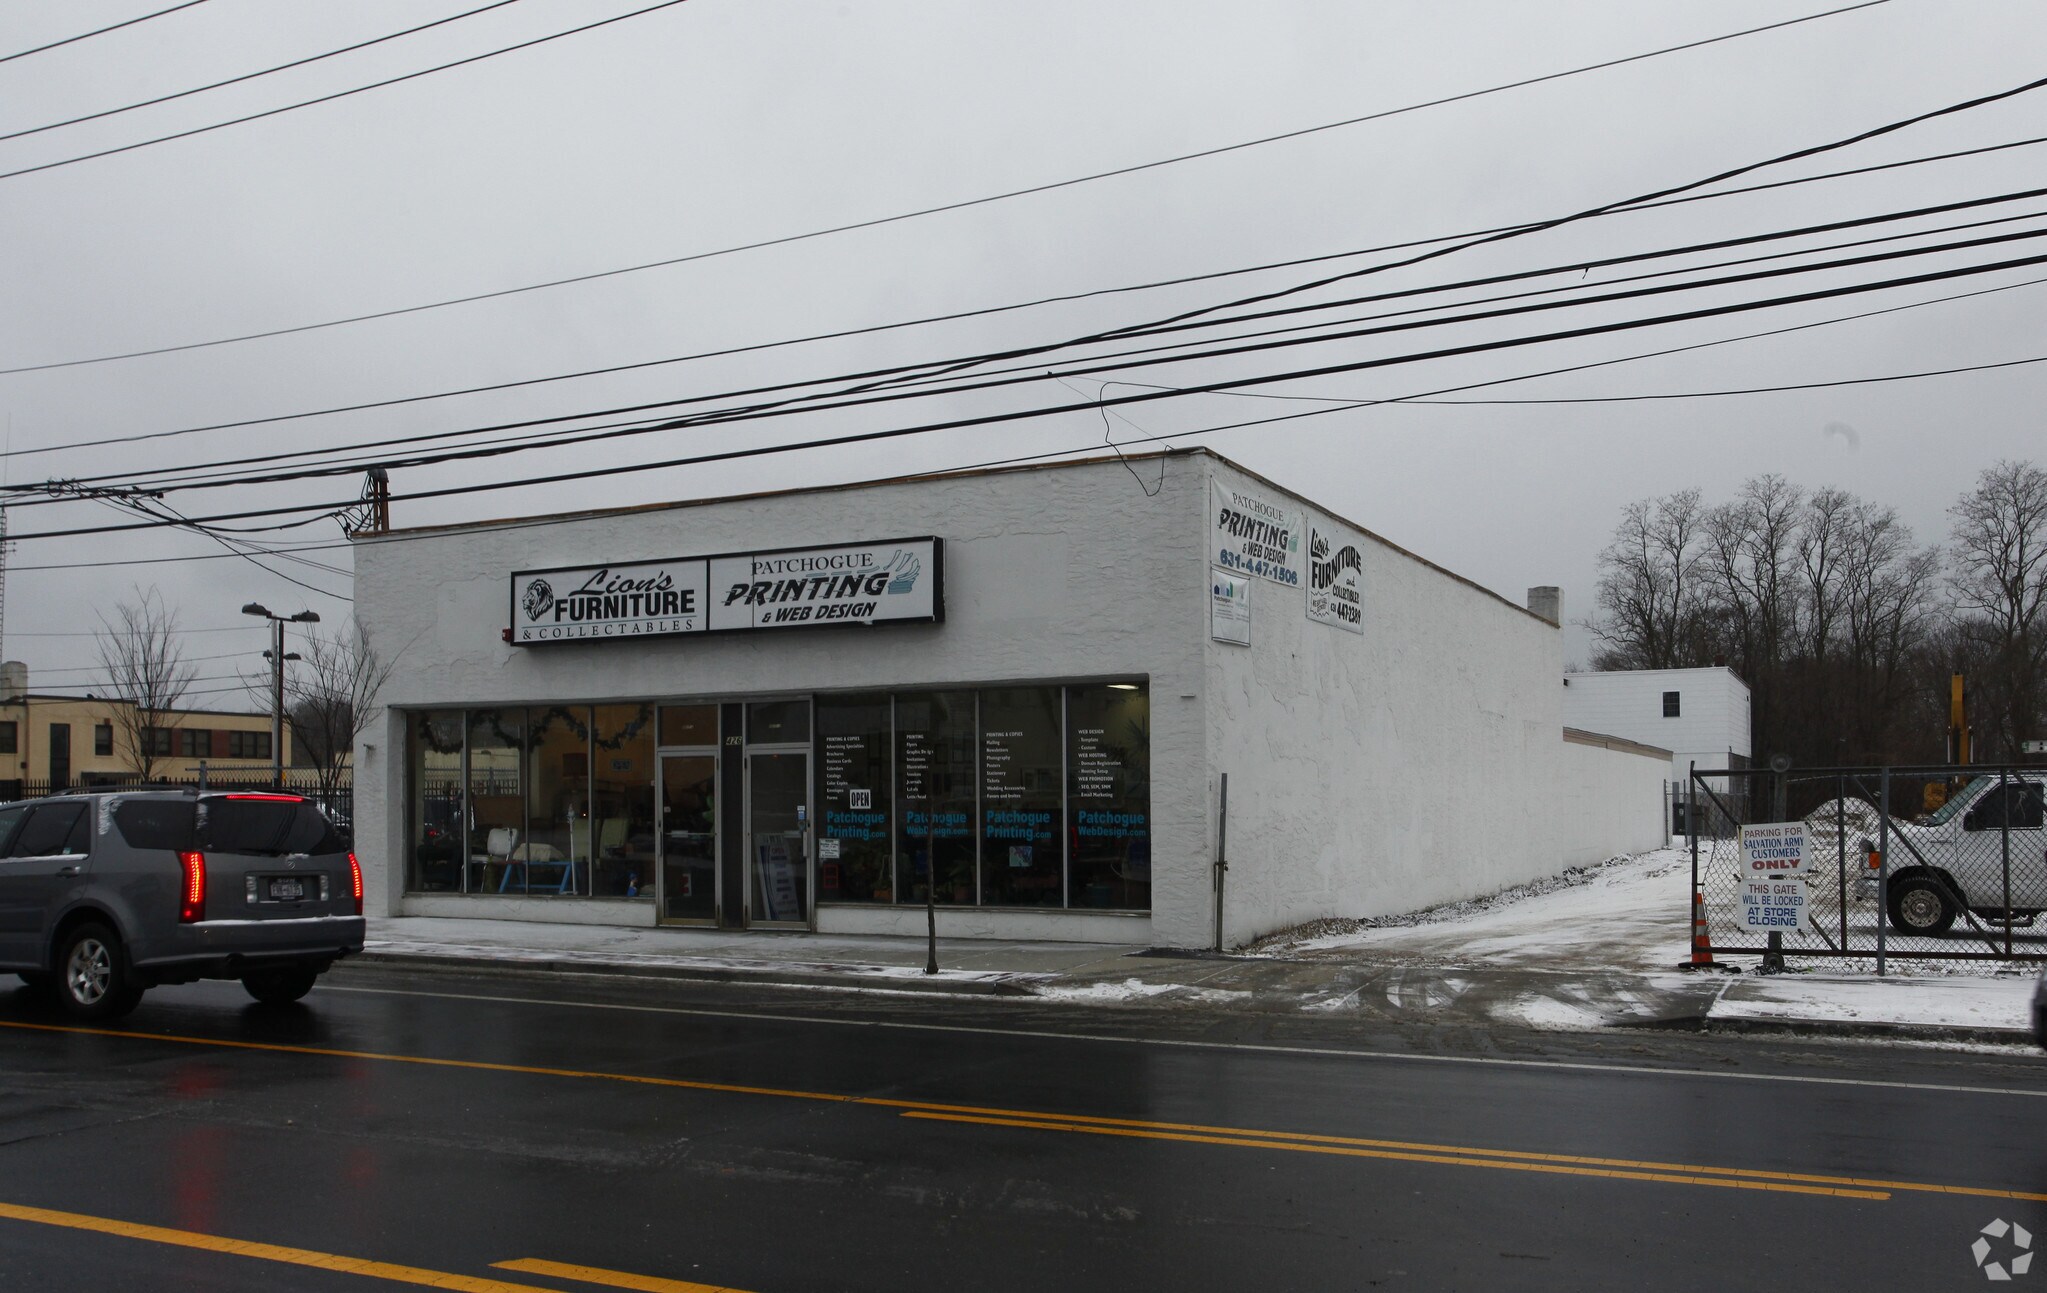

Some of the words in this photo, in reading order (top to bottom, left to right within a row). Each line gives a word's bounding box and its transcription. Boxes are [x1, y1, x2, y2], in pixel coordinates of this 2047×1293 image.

[1232, 492, 1284, 521] PATCHOGUE
[1218, 508, 1288, 550] PRINTING
[1310, 527, 1330, 560] Lion's
[1242, 544, 1246, 554] &
[1248, 542, 1262, 558] WEB
[1264, 547, 1286, 565] DESIGN
[751, 553, 873, 575] PATCHOGUE
[1220, 549, 1298, 585] 631-447-1506
[1312, 545, 1362, 589] FURNITURE
[568, 569, 674, 597] Lion's
[722, 572, 890, 606] PRINTING
[554, 589, 695, 622] FURNITURE
[762, 612, 772, 622] &
[775, 606, 812, 622] WEB
[815, 602, 877, 620] DESIGN
[522, 630, 532, 640] &
[540, 619, 693, 638] COLLECTABLES
[726, 736, 742, 746] 426
[851, 792, 869, 806] OPEN
[826, 810, 885, 826] Patchogue
[987, 810, 1050, 826] Patchogue
[1079, 811, 1145, 827] Patchogue
[826, 825, 886, 840] Printing.com
[906, 826, 968, 837] WebDsign.com
[987, 825, 1052, 841] Printing.com
[1078, 826, 1146, 838] WebDesign.com
[1744, 828, 1781, 838] PARKING
[1785, 827, 1802, 836] FOR
[1744, 839, 1782, 849] SALVATION
[1784, 837, 1804, 846] ARMY
[1752, 847, 1800, 859] CUSTOMERS
[1752, 859, 1801, 870] ONLY
[1748, 884, 1769, 894] THIS
[1774, 885, 1797, 894] GATE
[1743, 895, 1759, 904] WILL
[1762, 896, 1771, 905] BE
[1775, 896, 1803, 906] LOCKED
[1764, 908, 1796, 916] STORE
[1748, 917, 1797, 926] CLOSING
